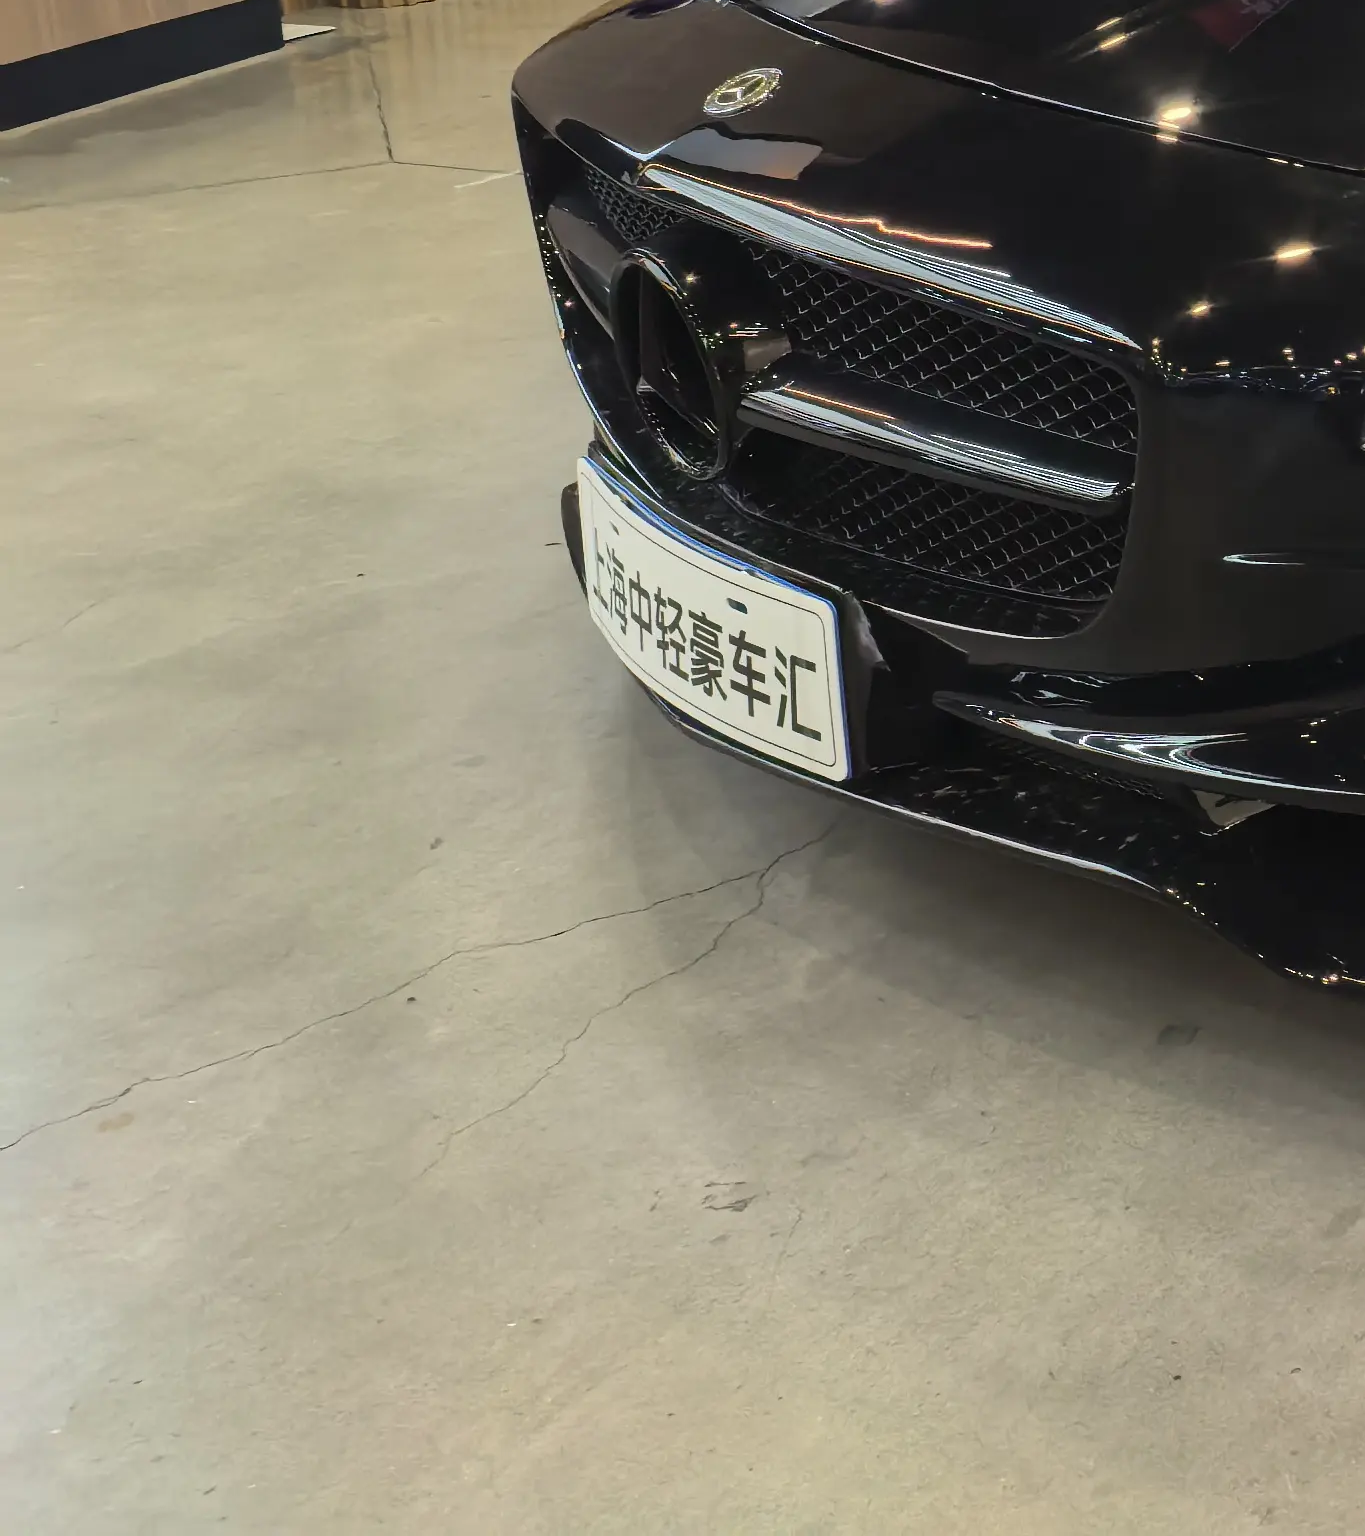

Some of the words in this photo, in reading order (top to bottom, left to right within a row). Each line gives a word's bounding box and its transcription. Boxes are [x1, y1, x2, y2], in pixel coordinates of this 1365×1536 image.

[592, 527, 822, 742] 上海中轻豪车汇
